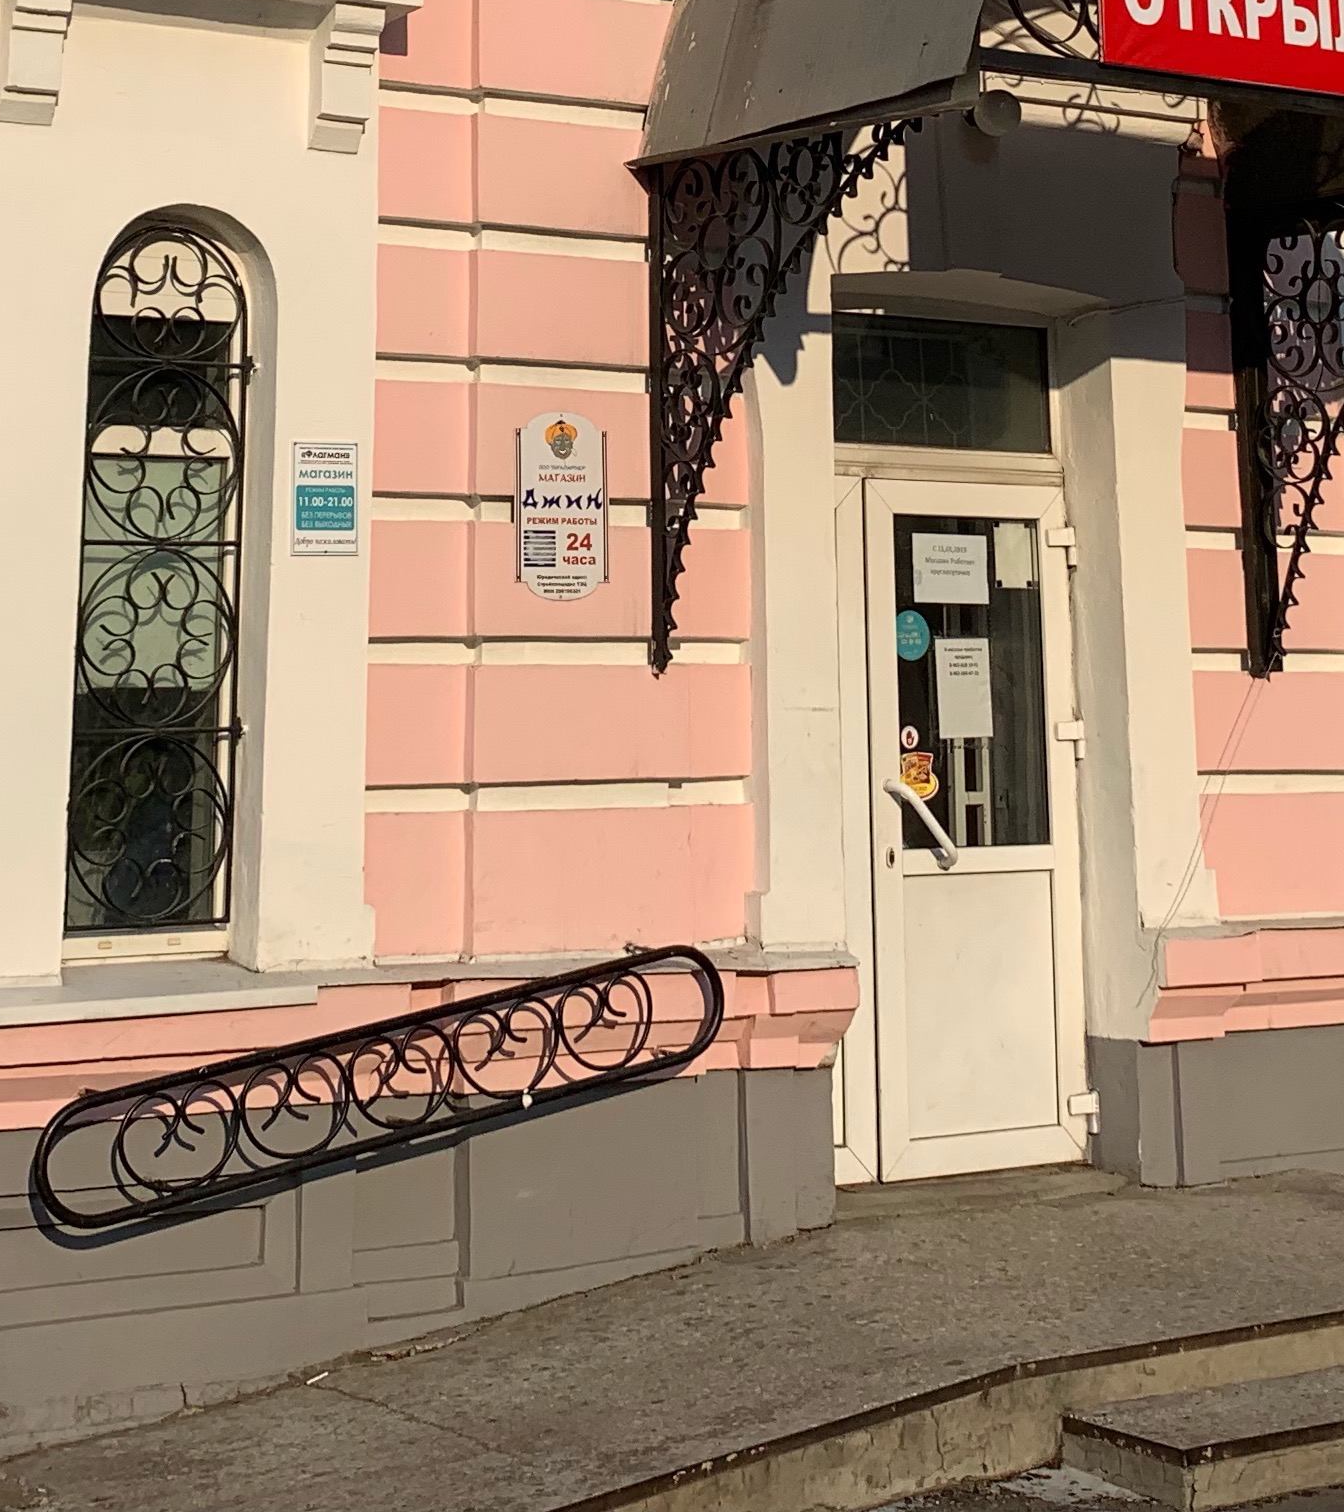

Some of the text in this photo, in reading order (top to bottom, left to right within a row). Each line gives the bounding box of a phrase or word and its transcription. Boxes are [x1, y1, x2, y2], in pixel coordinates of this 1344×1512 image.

[299, 470, 353, 479] магазин
[538, 473, 586, 482] МАГАЗИН
[299, 496, 353, 507] 11.00-21.00
[527, 517, 597, 525] РЕЖИМ РАБОТЫ
[567, 533, 592, 551] 24
[563, 555, 596, 565] часа
